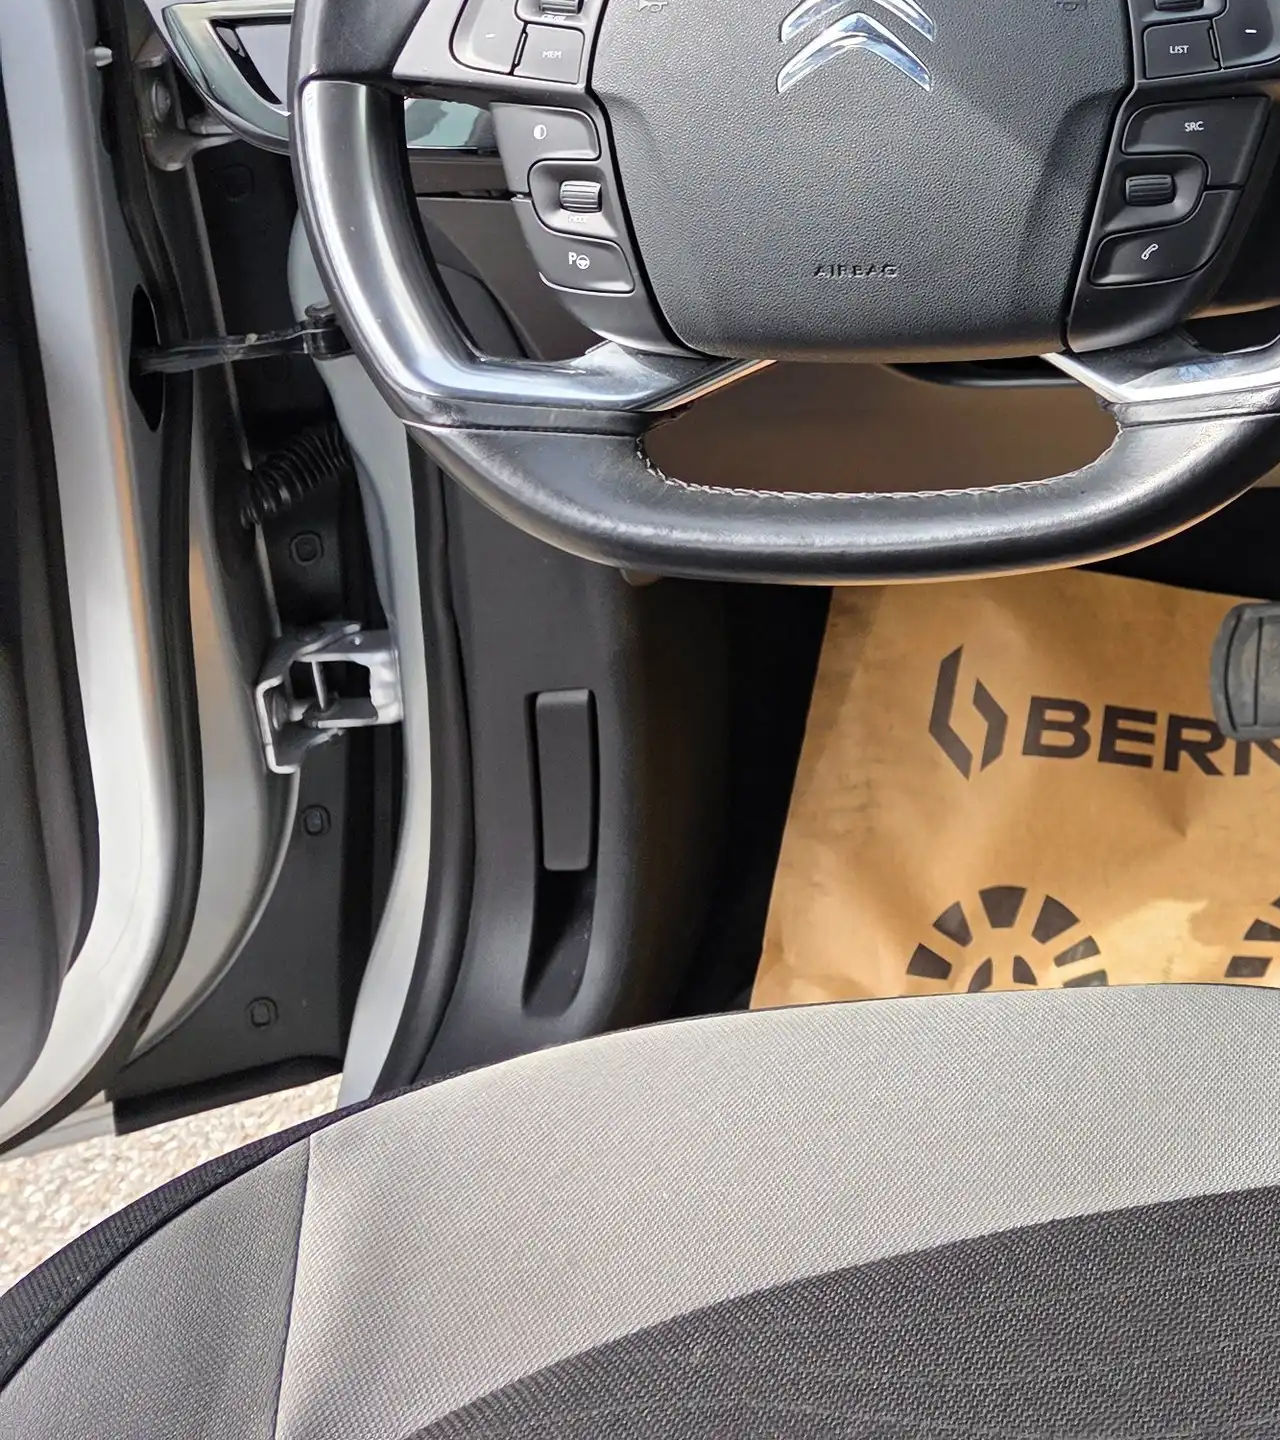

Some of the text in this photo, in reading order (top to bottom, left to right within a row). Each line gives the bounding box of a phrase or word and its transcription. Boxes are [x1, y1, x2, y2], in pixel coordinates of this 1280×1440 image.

[542, 50, 562, 59] MEM
[1169, 45, 1190, 54] LIST
[1184, 121, 1204, 132] SRC
[814, 263, 898, 278] AIRBAG
